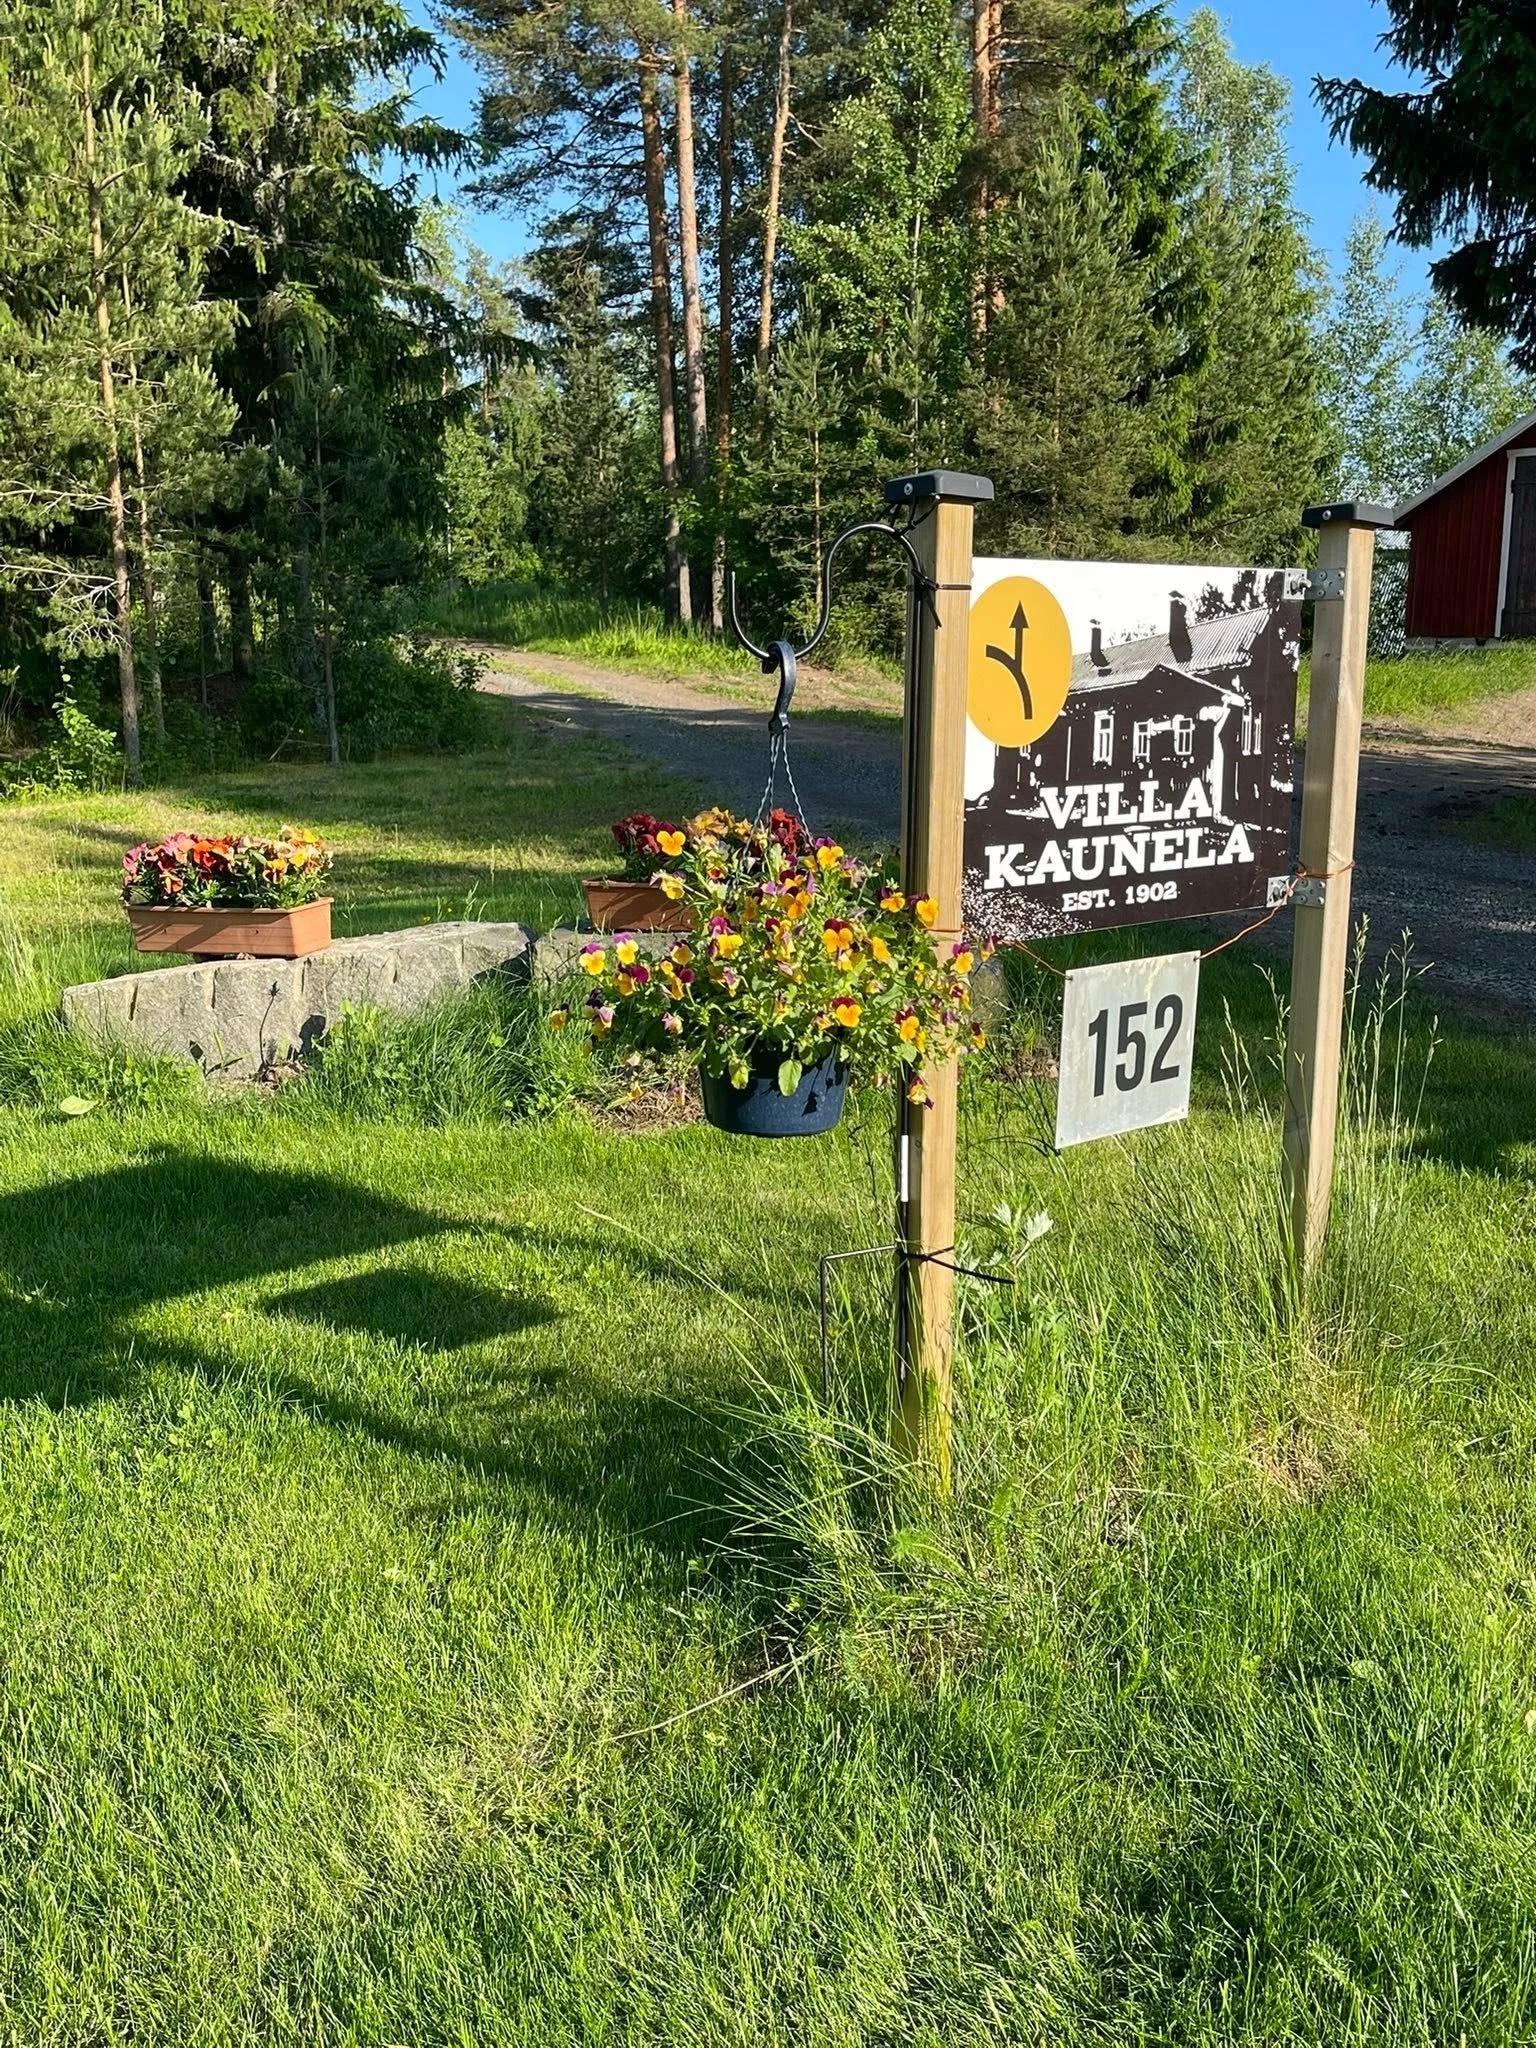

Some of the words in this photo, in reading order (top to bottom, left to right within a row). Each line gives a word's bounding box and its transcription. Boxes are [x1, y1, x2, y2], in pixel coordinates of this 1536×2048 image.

[1039, 777, 1212, 830] VILLA
[983, 823, 1254, 890] KAUNELA
[1062, 889, 1116, 913] EST.
[1125, 881, 1178, 905] 1902
[1088, 994, 1183, 1098] 152
